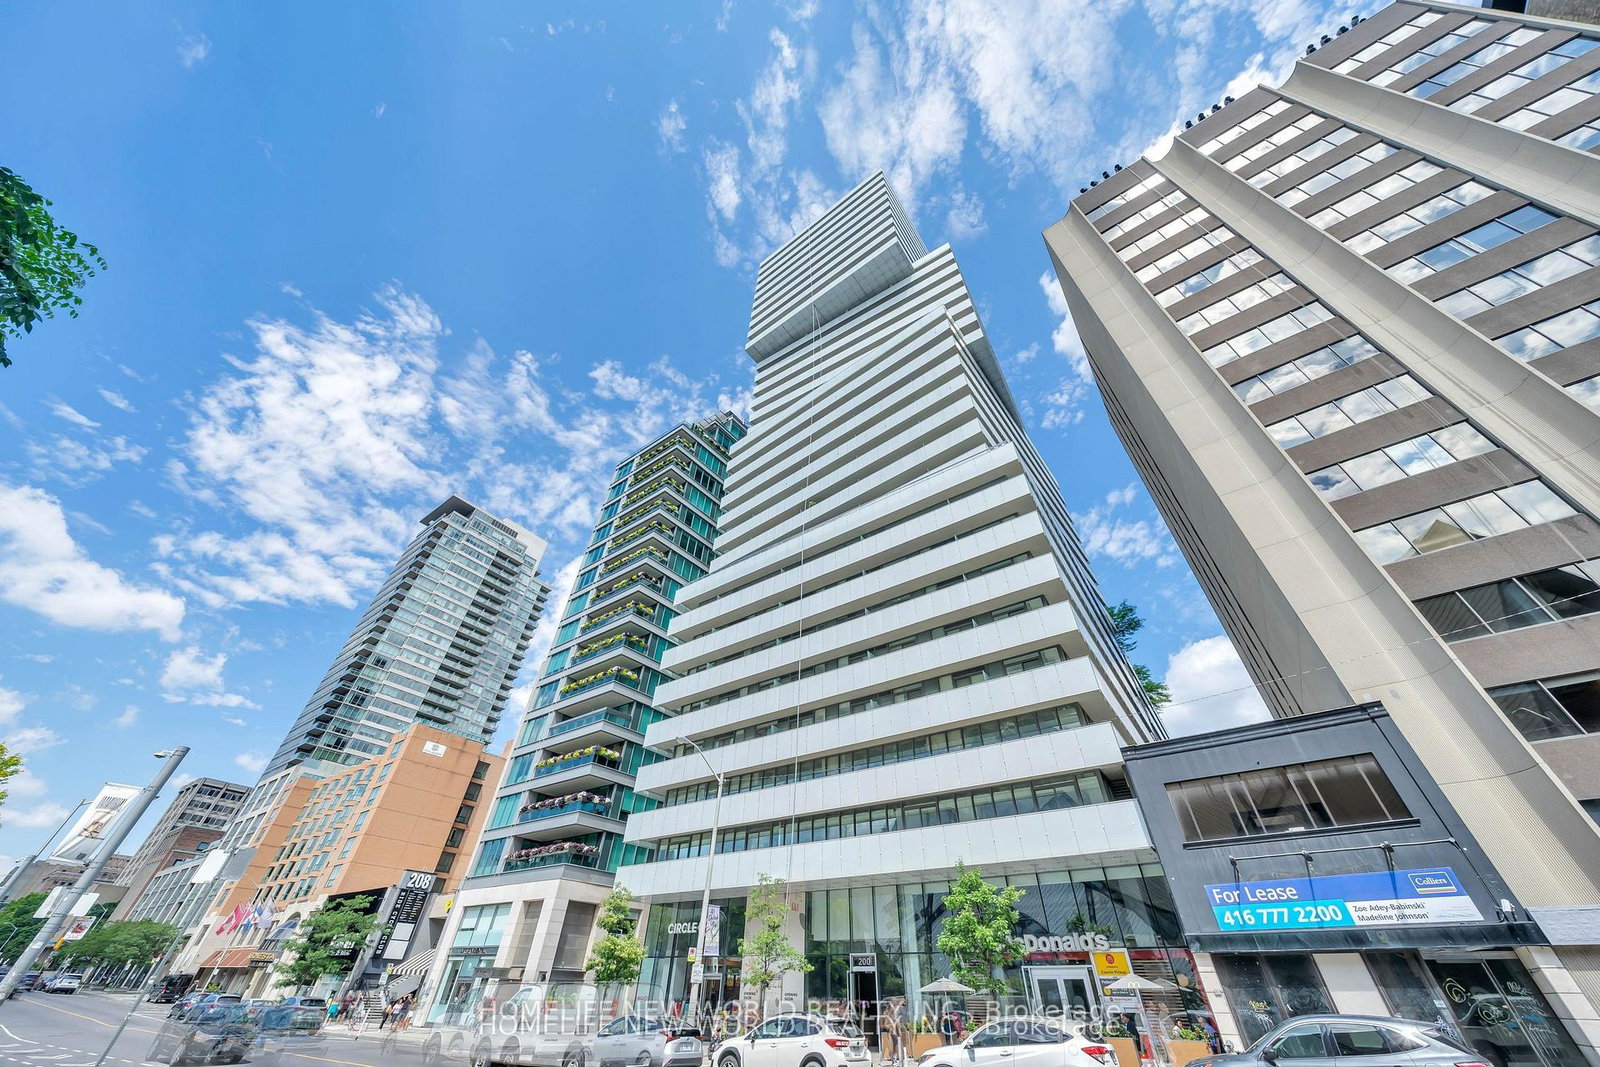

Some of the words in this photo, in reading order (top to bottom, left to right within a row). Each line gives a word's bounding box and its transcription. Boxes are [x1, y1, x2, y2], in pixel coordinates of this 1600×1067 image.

[406, 873, 432, 889] 208
[1415, 877, 1448, 886] Colliers
[1212, 888, 1240, 903] For
[1244, 886, 1298, 901] Lease
[1352, 905, 1368, 913] Zoe
[1224, 909, 1255, 926] 416
[1256, 907, 1288, 924] 777
[1294, 905, 1343, 923] 2200
[1357, 913, 1394, 922] Madeline
[1395, 912, 1429, 922] Johnson
[668, 922, 698, 934] CIRCLE
[858, 958, 871, 966] 200
